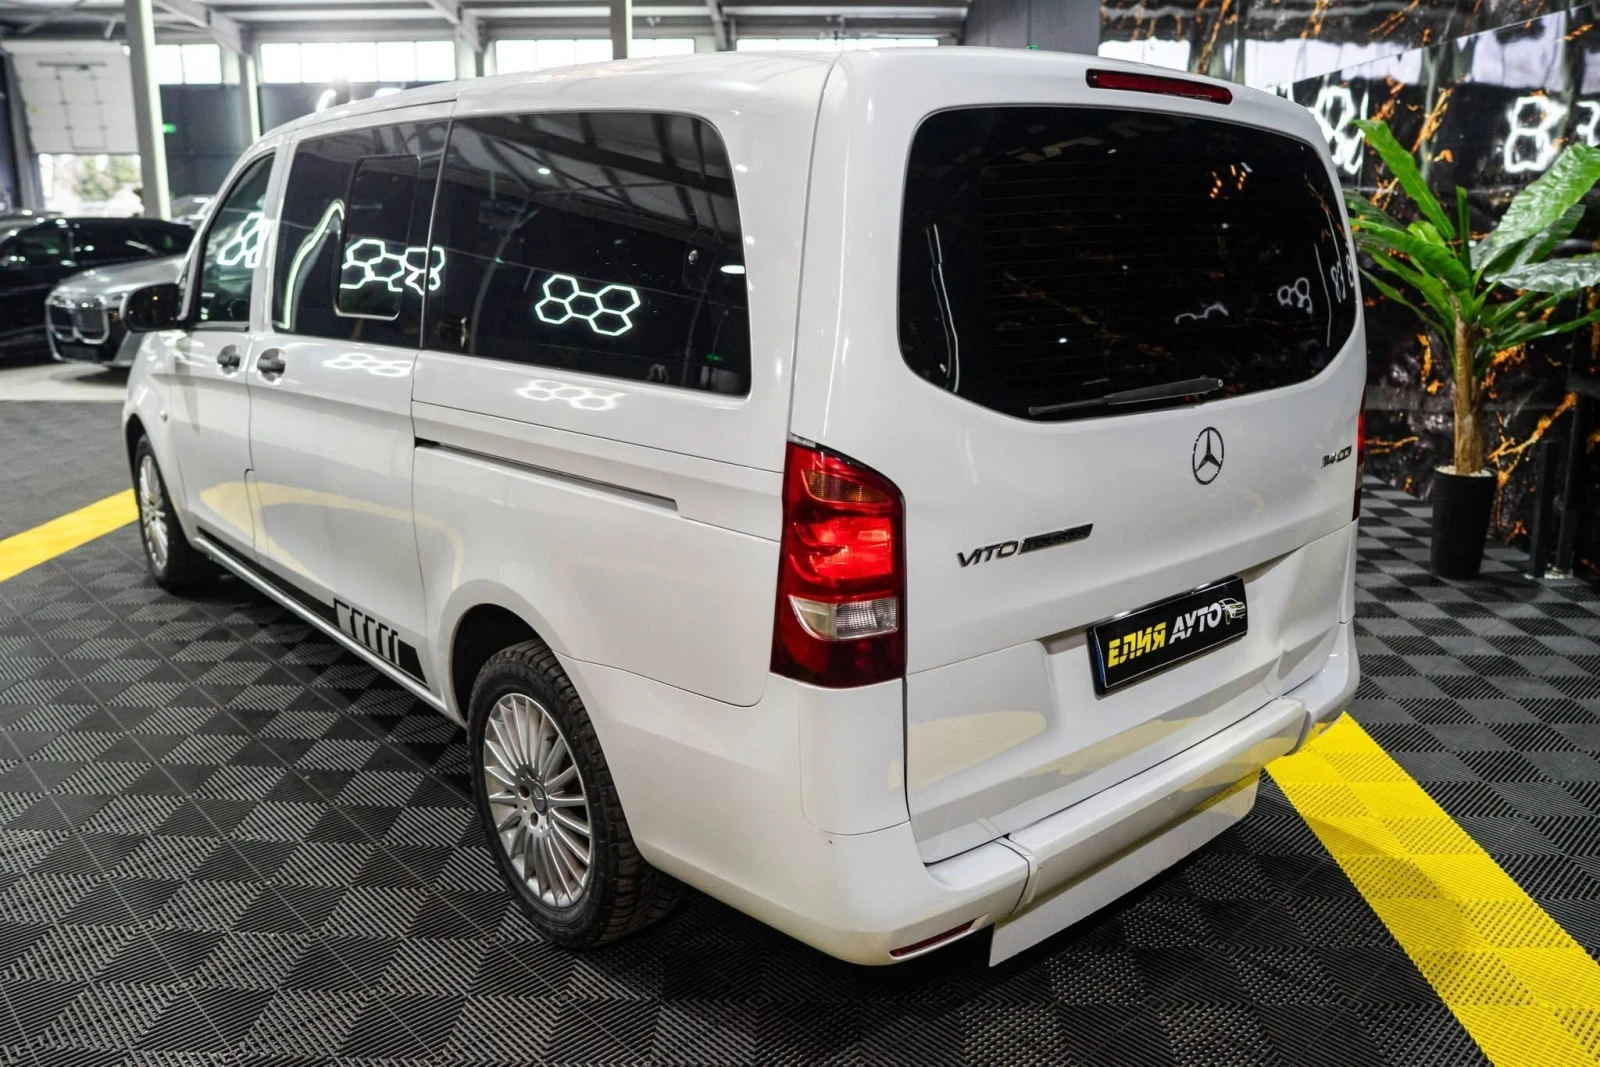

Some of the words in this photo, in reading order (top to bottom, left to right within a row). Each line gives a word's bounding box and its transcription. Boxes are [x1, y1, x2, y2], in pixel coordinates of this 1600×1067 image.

[957, 540, 1019, 568] VITO
[1108, 621, 1167, 668] ЕЛИЯ
[1169, 602, 1222, 645] АУТО
